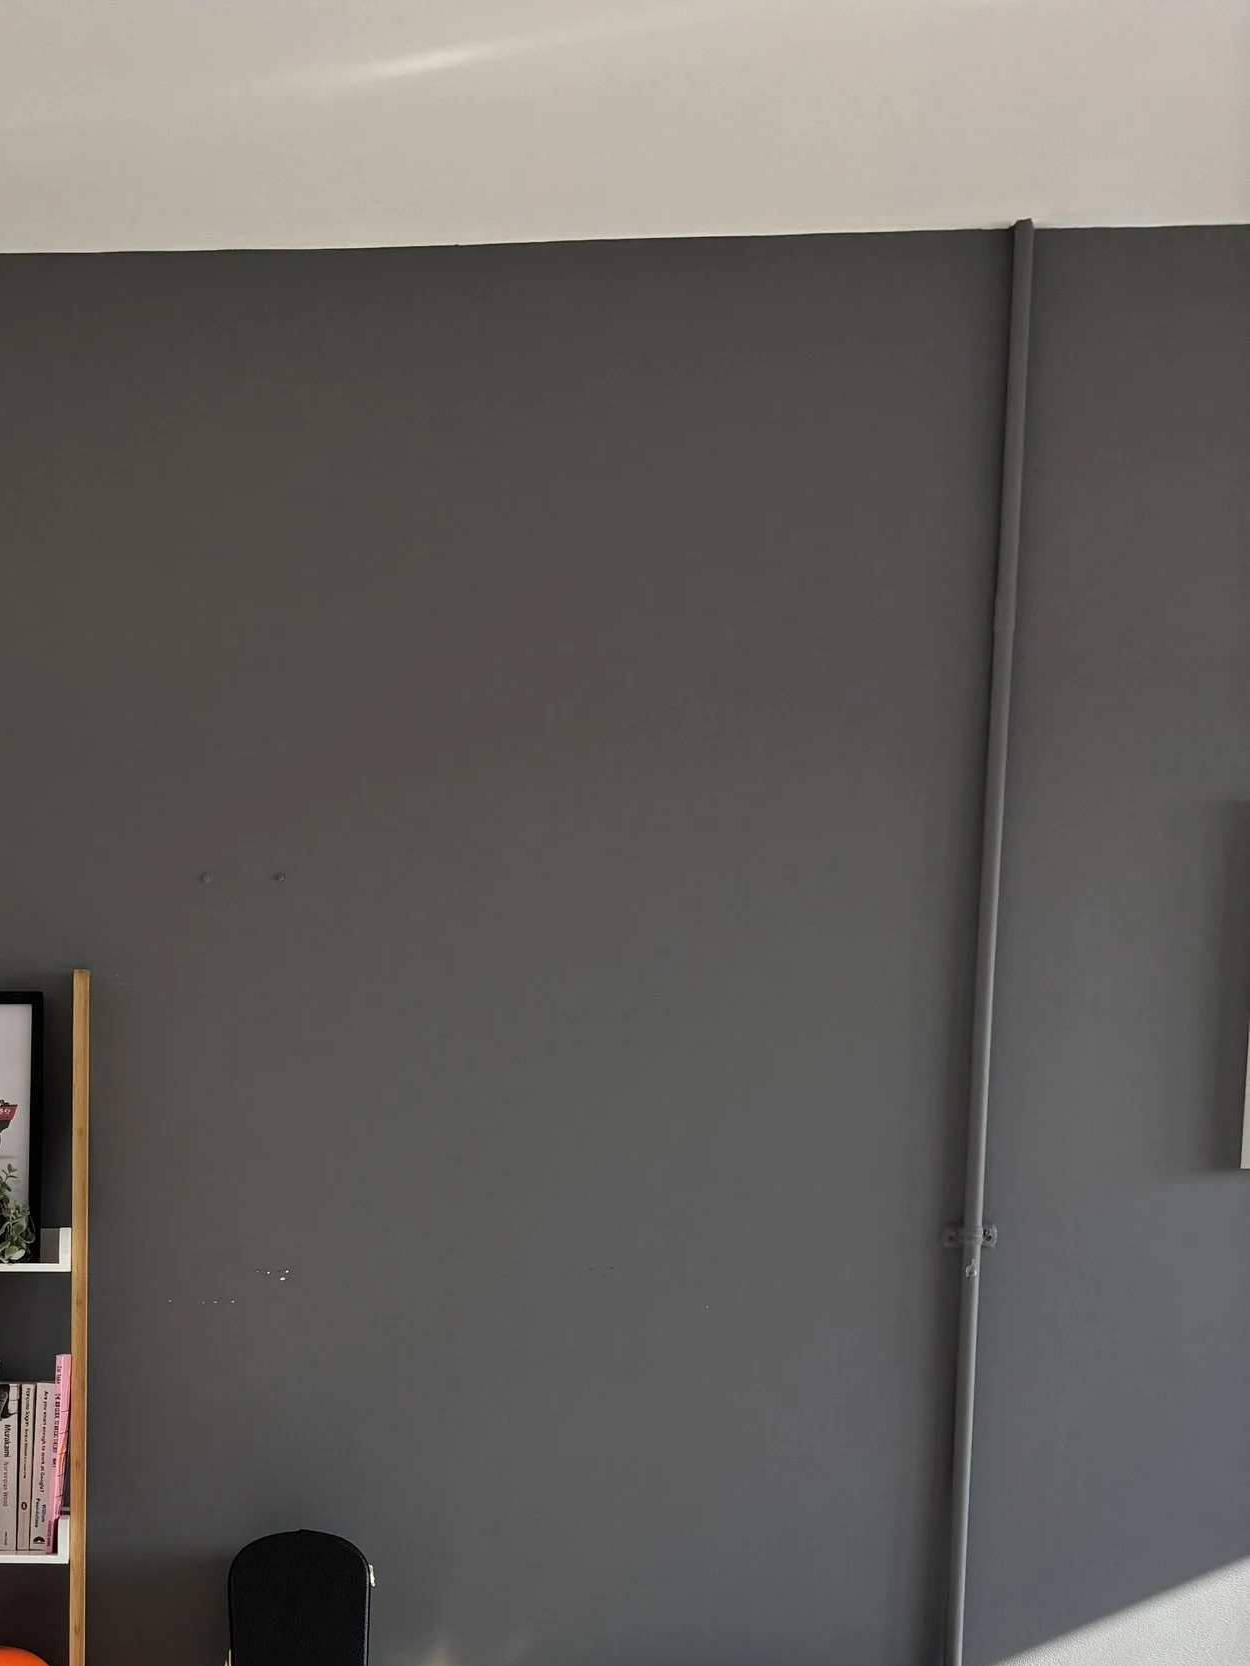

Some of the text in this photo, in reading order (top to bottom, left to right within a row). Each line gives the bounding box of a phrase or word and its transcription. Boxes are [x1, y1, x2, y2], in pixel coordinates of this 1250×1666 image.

[23, 1411, 31, 1427] Sagan
[3, 1424, 12, 1458] Murakami
[40, 1426, 48, 1445] enough
[2, 1461, 10, 1490] Norwegian
[38, 1472, 47, 1493] Google?
